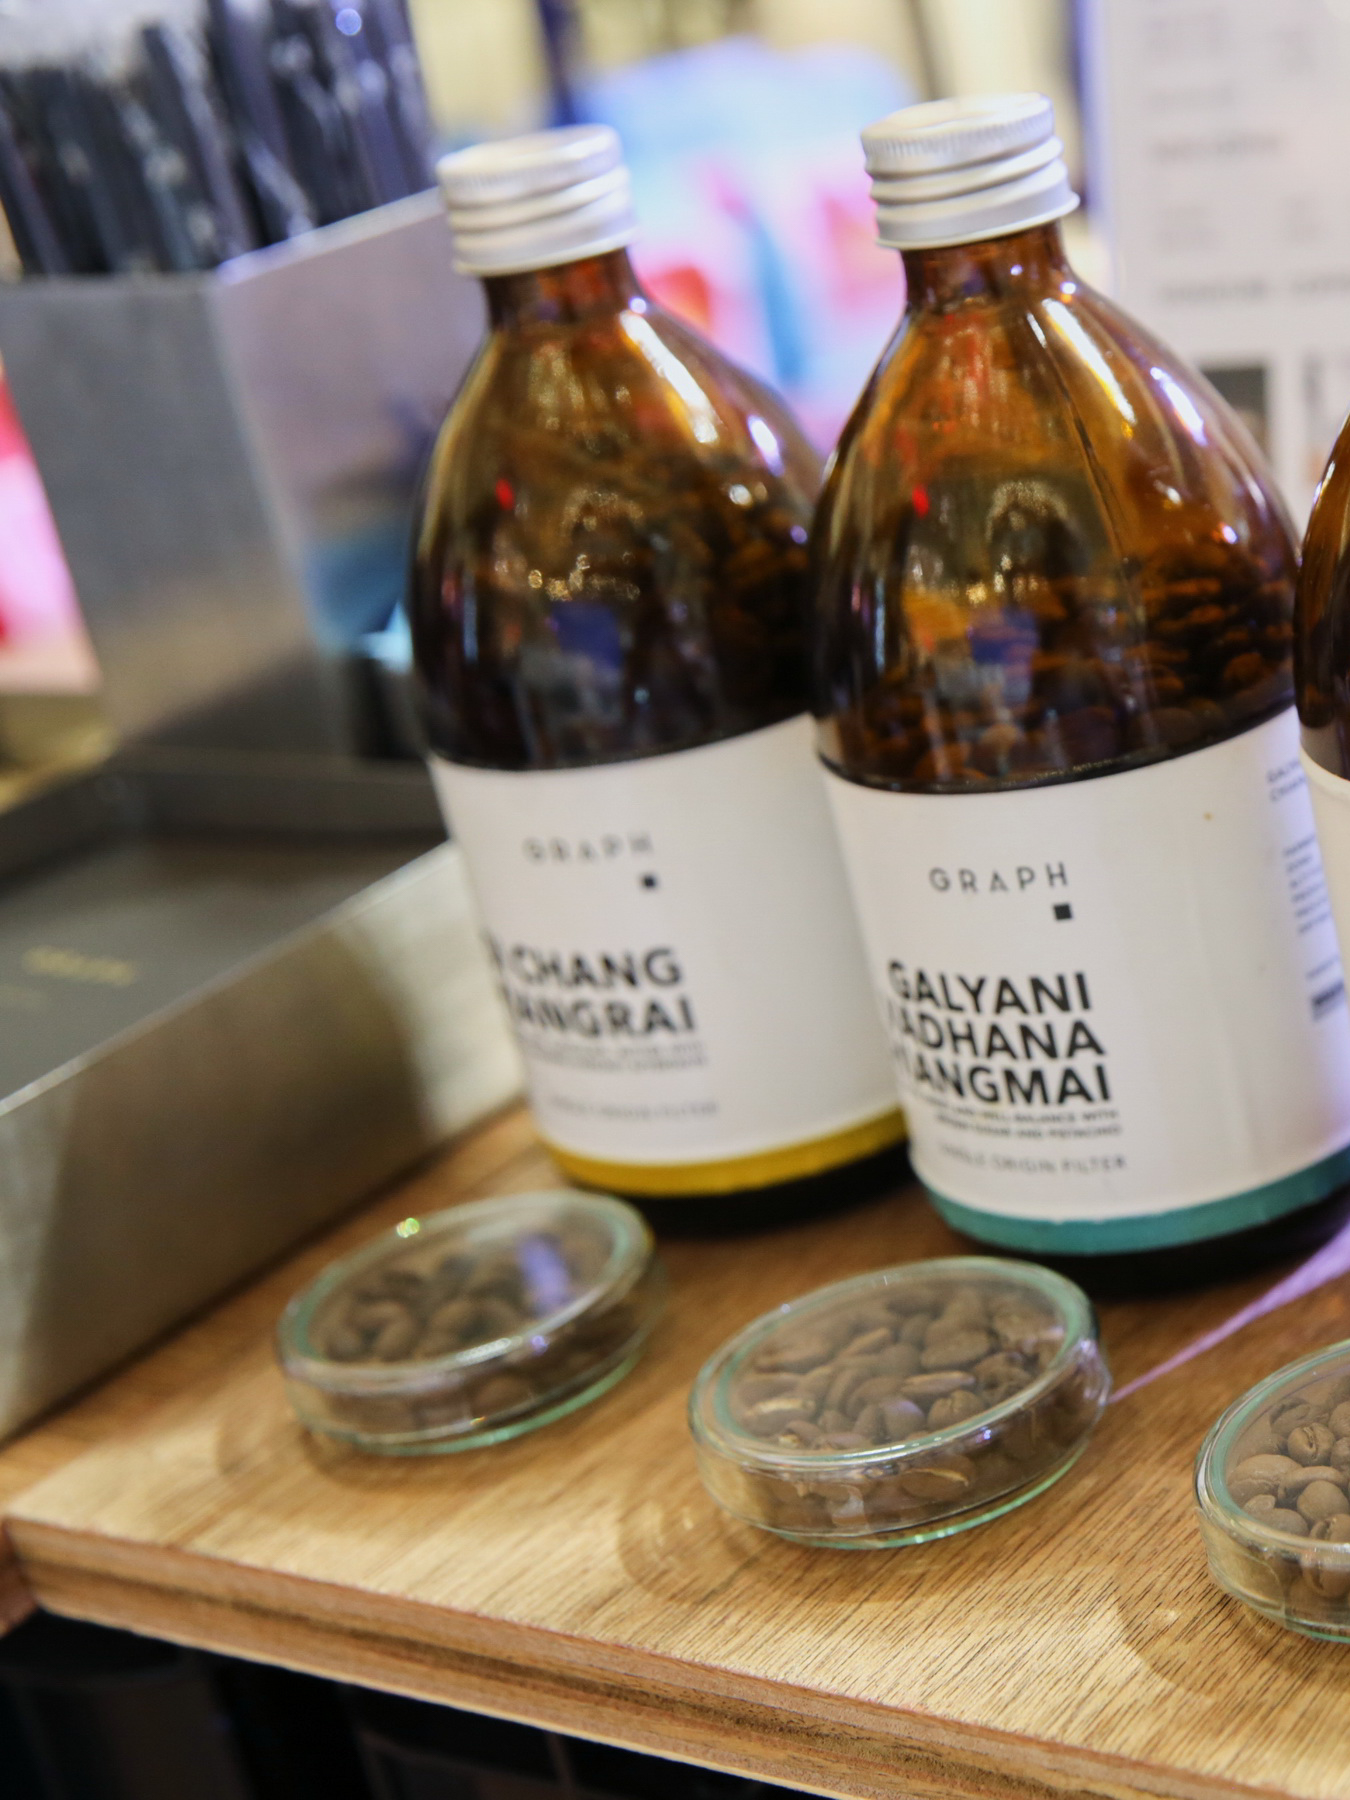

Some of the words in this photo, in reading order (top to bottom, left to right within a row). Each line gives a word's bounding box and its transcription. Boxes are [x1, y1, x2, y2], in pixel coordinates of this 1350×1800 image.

[929, 862, 1068, 892] GRAPH
[510, 945, 682, 988] CHANG
[888, 959, 1092, 1015] GALYANI
[500, 985, 696, 1038] ANGRAI
[889, 1002, 1106, 1060] ADHANA
[900, 1048, 1112, 1106] ANGMAI
